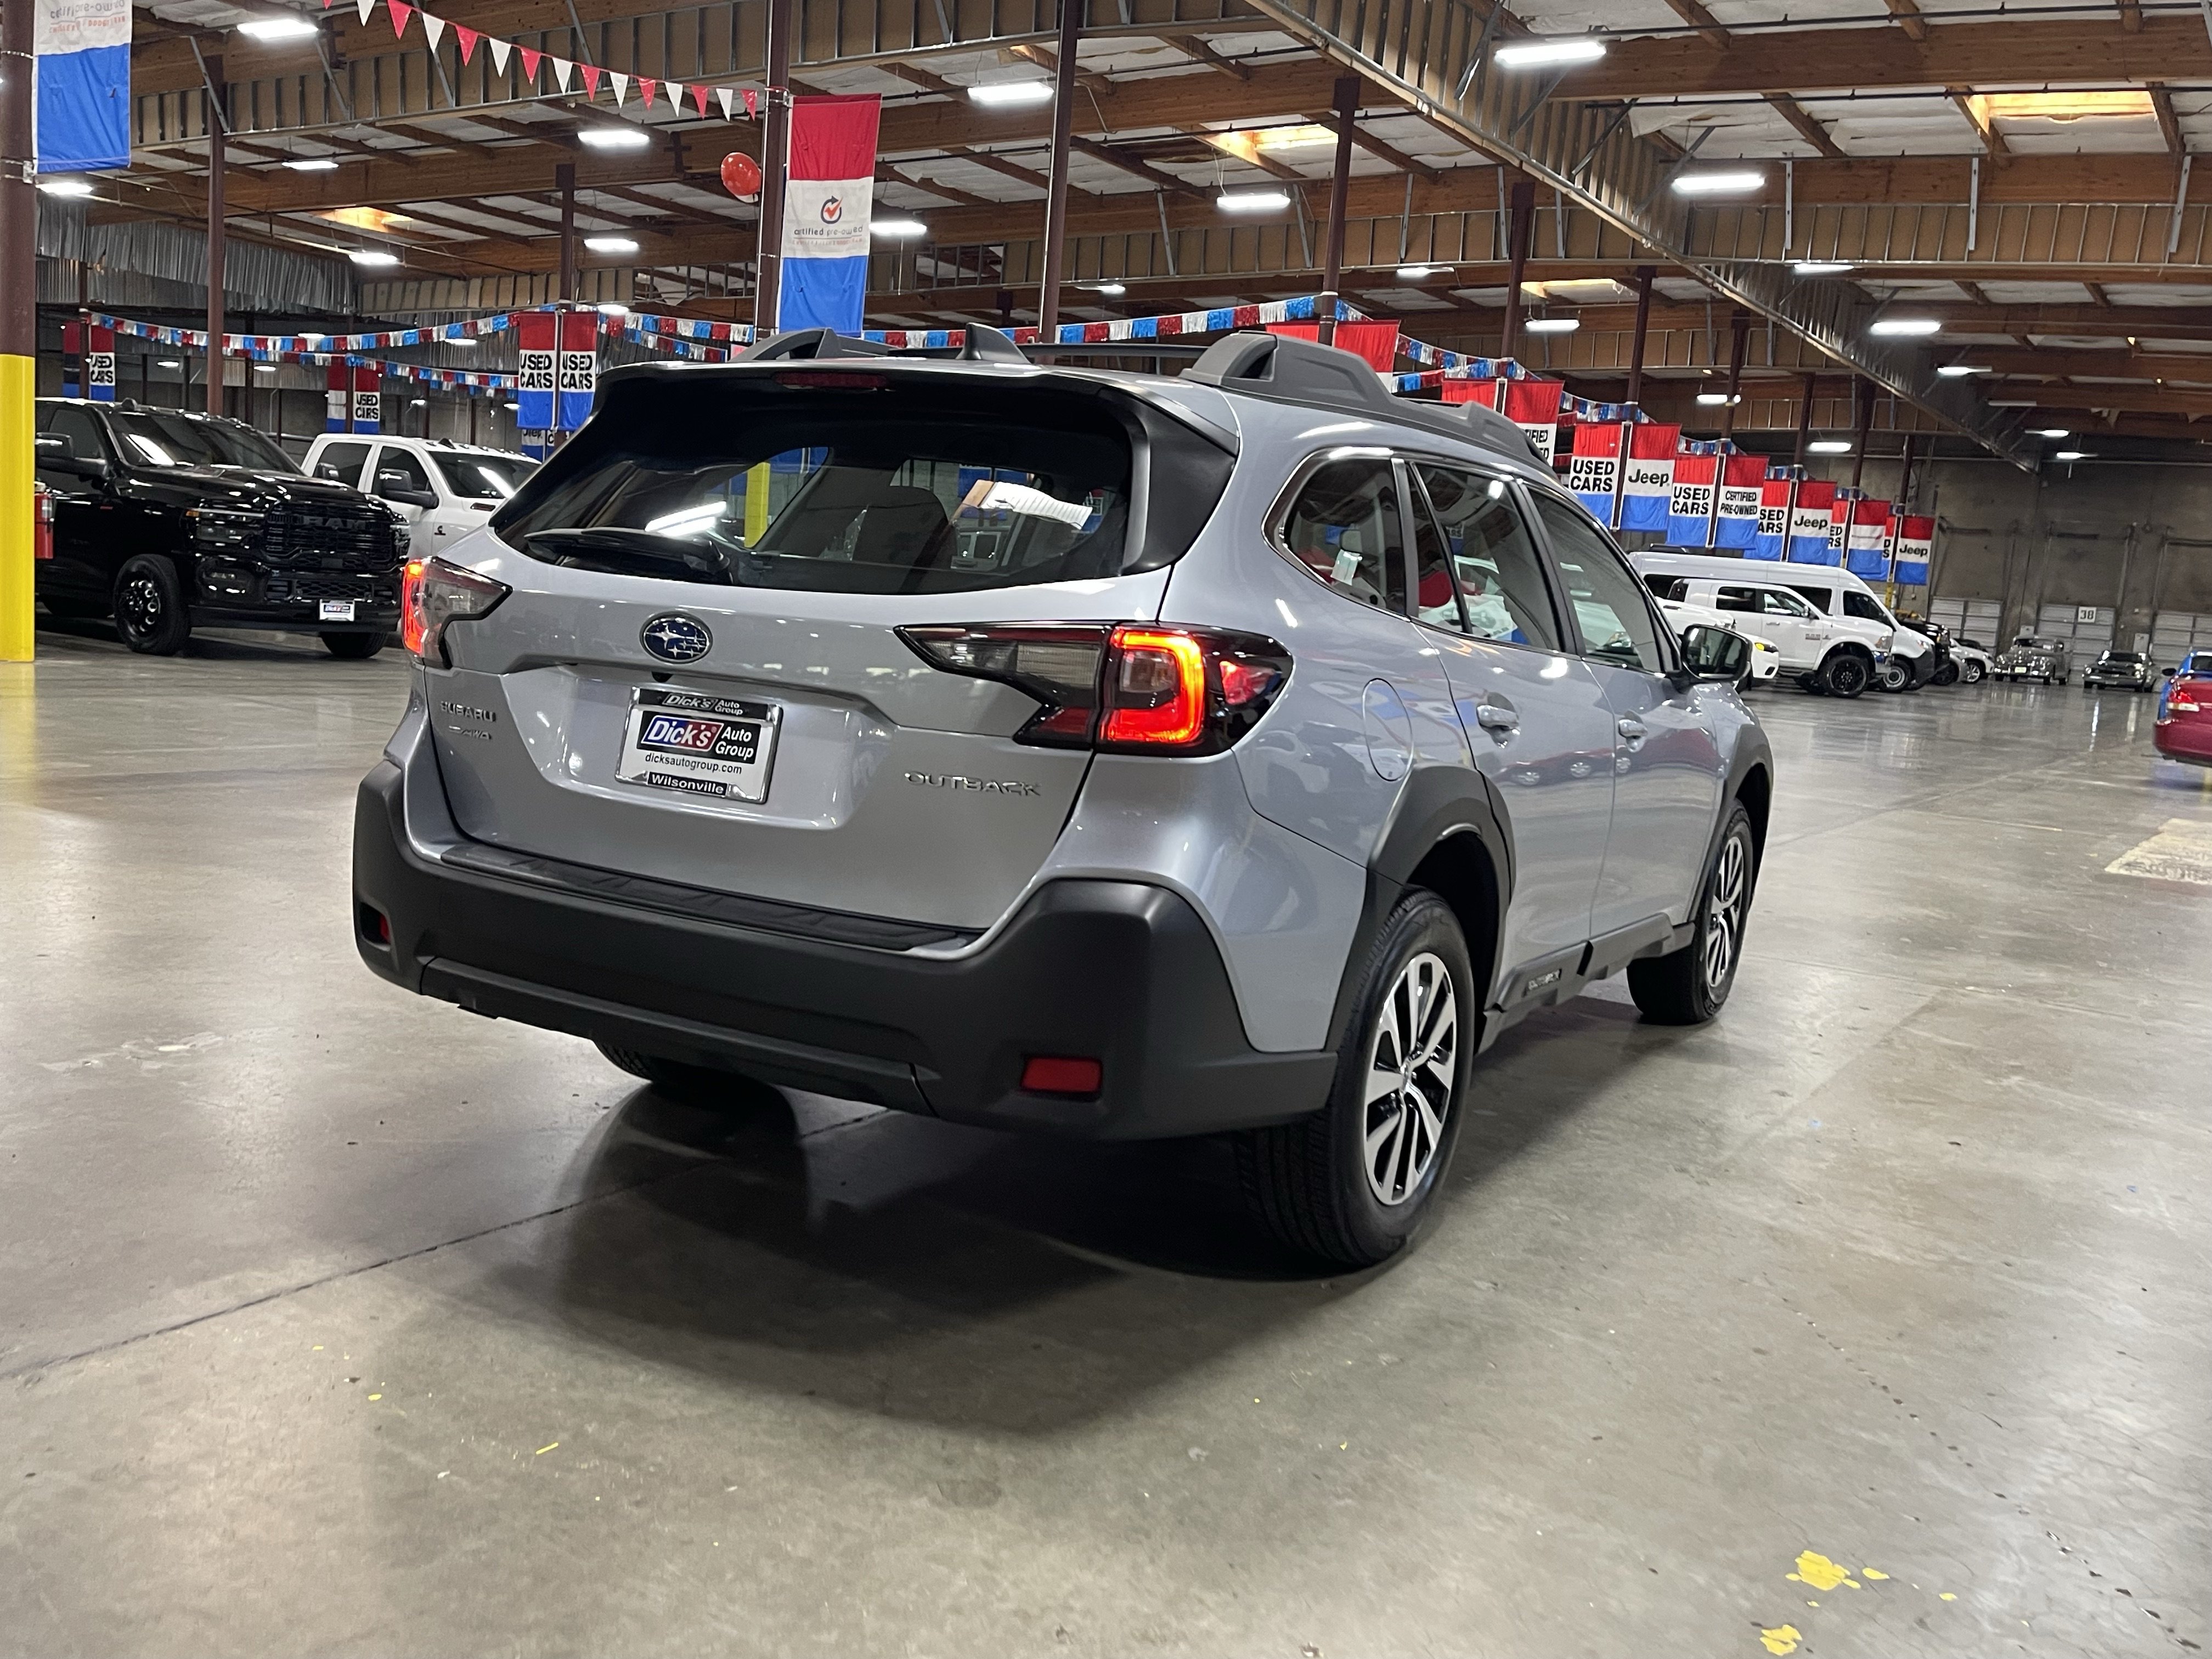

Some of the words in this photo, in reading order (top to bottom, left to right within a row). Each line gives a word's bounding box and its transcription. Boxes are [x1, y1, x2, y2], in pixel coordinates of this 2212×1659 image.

[520, 353, 552, 370] USED
[562, 354, 592, 371] USED
[520, 372, 553, 389] CARS
[561, 372, 592, 389] CARS
[1573, 459, 1615, 475] USED
[1570, 476, 1613, 492] CARS
[1628, 469, 1669, 487] Jeep
[1673, 486, 1710, 500] USED
[1725, 490, 1757, 501] CERTIFIED
[1672, 500, 1709, 515] CARS
[1720, 503, 1758, 515] PRE-OWNED
[1759, 509, 1785, 521] SED
[1758, 522, 1783, 533] ARS
[1794, 515, 1828, 530] Jeep
[1830, 526, 1843, 536] ED
[1899, 544, 1928, 557] Jeep
[2080, 610, 2094, 620] 38
[665, 694, 712, 709] Dick's
[718, 699, 740, 708] Auto
[714, 706, 743, 715] Group
[647, 720, 712, 747] Dick's
[721, 726, 752, 742] Auto
[715, 742, 754, 760] Group
[645, 753, 742, 774] dicksautogroup.com
[651, 774, 725, 794] Wilsonville
[904, 770, 1041, 796] OUTBACK
